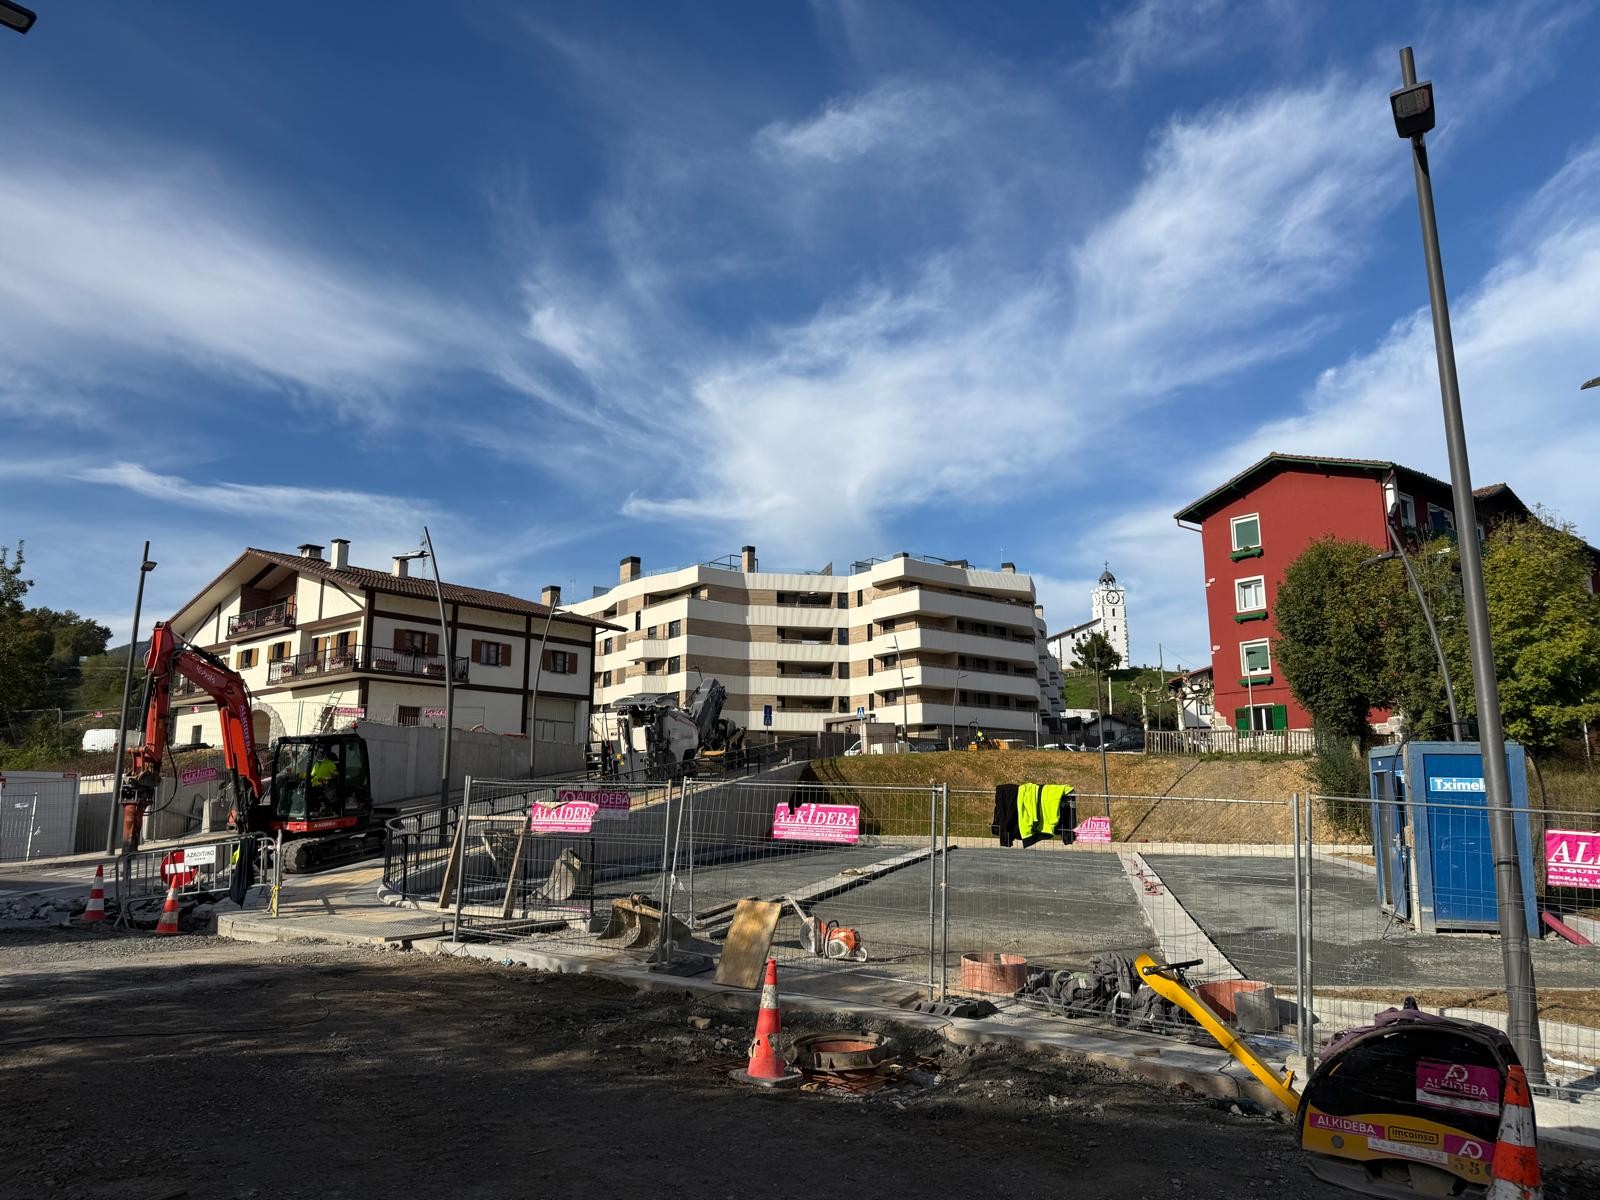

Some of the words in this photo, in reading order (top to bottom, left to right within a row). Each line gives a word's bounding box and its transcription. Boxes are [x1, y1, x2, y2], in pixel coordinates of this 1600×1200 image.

[1548, 840, 1600, 864] AL
[1424, 1078, 1489, 1098] ALKIDEBA
[1318, 1116, 1376, 1135] ALKIDEBA
